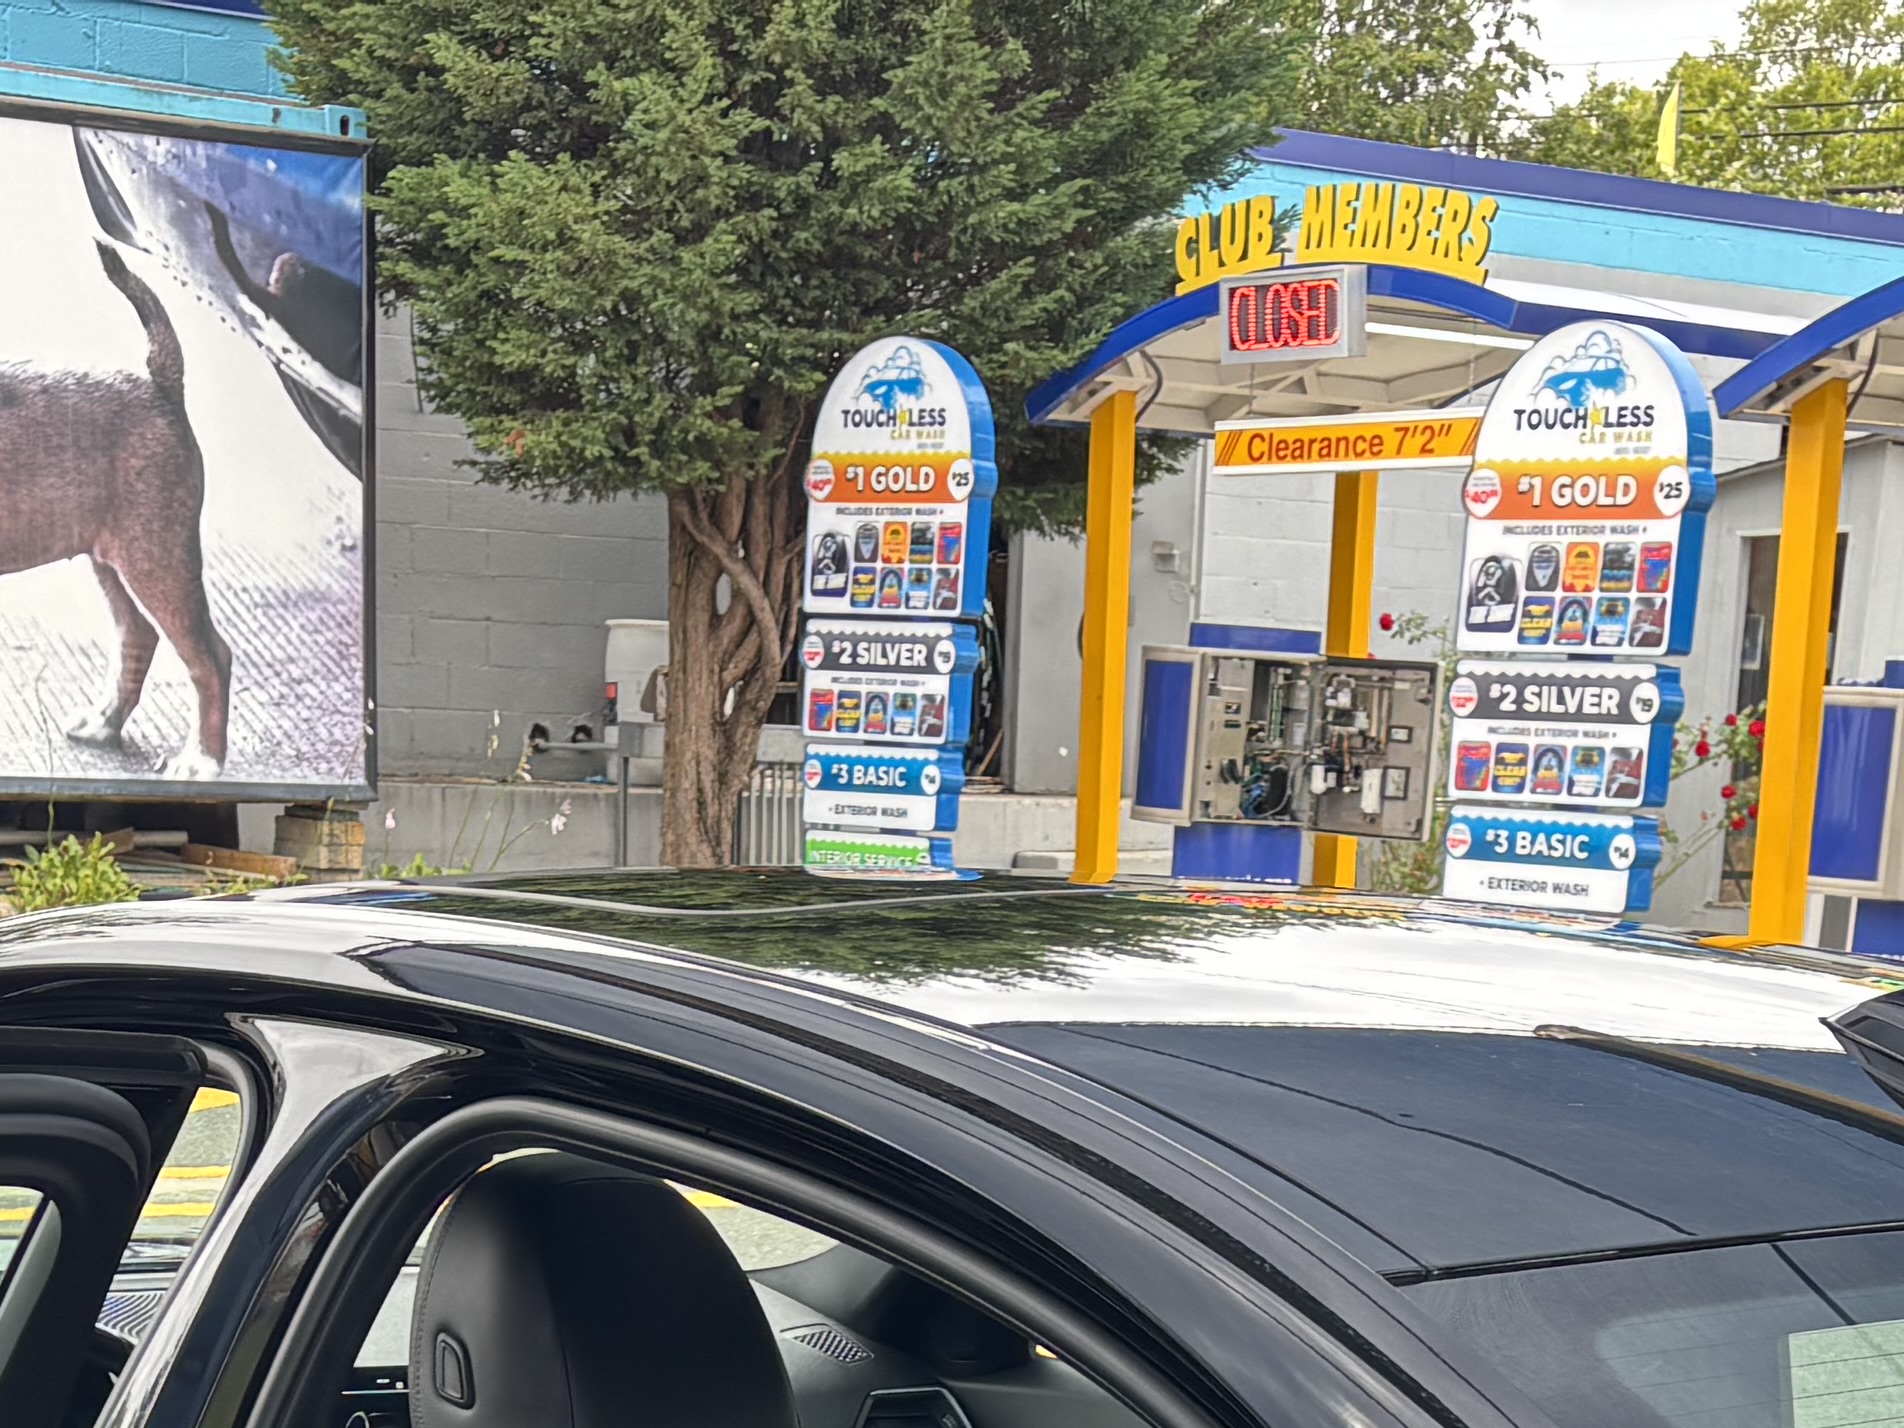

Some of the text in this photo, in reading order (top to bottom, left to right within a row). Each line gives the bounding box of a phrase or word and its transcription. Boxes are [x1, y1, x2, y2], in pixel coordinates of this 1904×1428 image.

[1175, 182, 1499, 286] CLUB MEMBERS
[1230, 278, 1341, 351] CLOSED
[1246, 431, 1384, 462] Clearance
[1579, 431, 1653, 444] CAR WASH
[870, 465, 936, 493] GOLD
[1551, 474, 1638, 508] GOLD
[856, 641, 928, 667] SILVER
[1522, 684, 1621, 715] SILVER
[853, 764, 907, 787] BASIC
[1515, 830, 1590, 860] BASIC
[1487, 876, 1589, 896] EXTERIOR WASH
